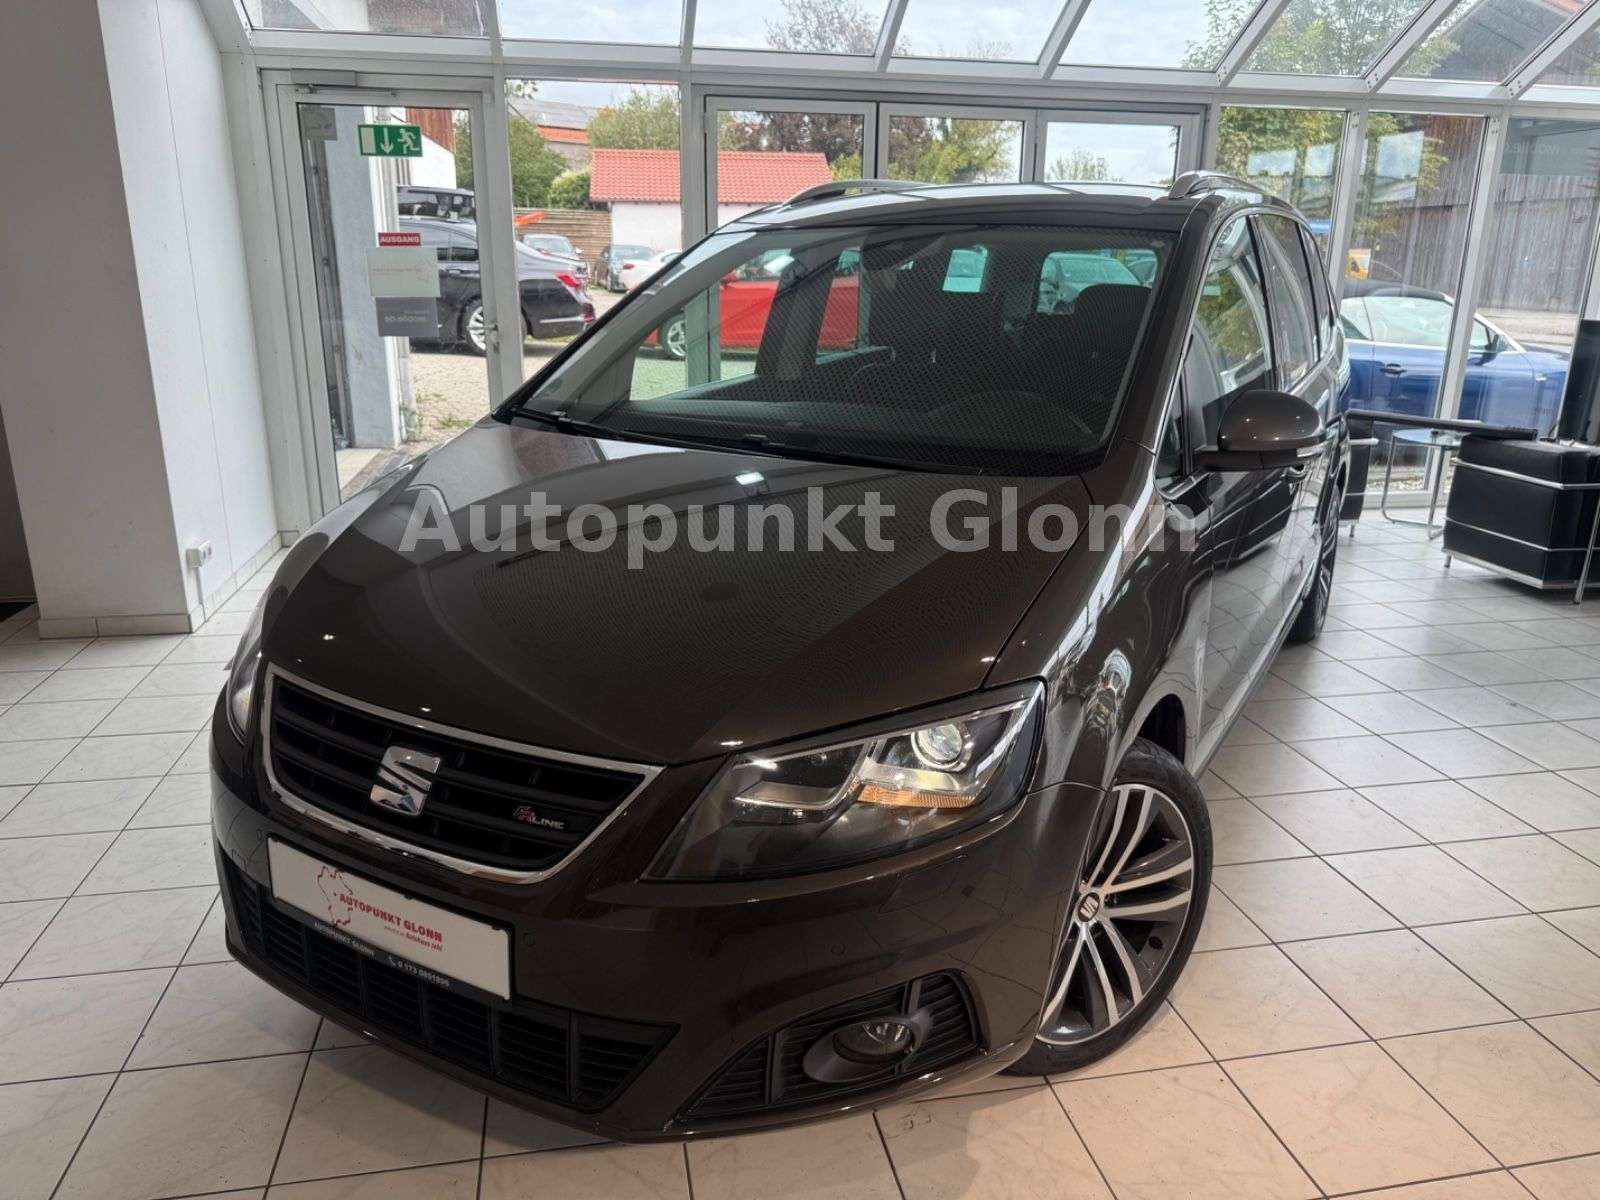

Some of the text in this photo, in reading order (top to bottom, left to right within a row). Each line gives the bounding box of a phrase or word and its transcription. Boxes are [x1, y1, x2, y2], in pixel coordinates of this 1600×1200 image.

[380, 235, 420, 244] AUSGANG
[340, 893, 402, 927] AUTOPUNKT
[403, 919, 443, 943] GLONN
